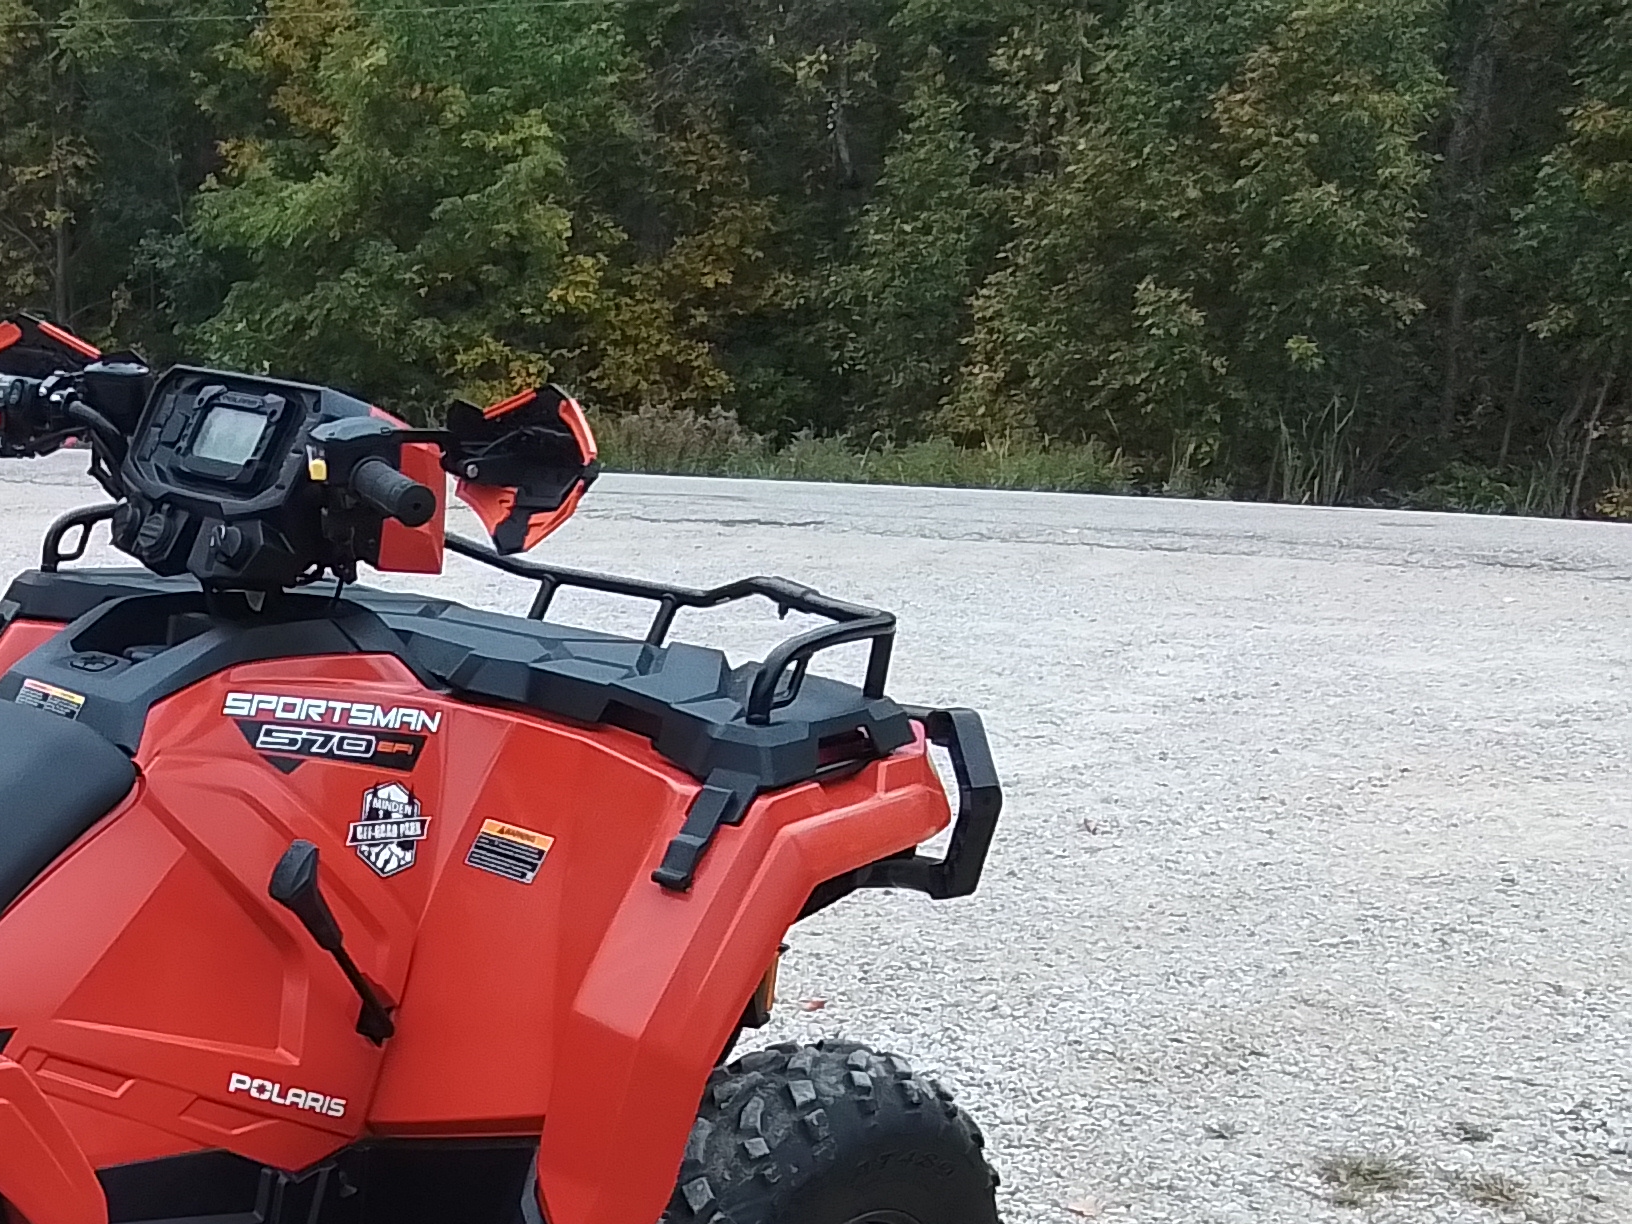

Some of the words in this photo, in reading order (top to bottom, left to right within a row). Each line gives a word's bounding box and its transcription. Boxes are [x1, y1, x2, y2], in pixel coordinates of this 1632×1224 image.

[223, 692, 442, 732] SPORTSMAN
[256, 724, 376, 758] 570
[377, 740, 414, 756] EFI
[372, 797, 412, 816] MINDEN
[228, 1072, 347, 1117] POLARIS
